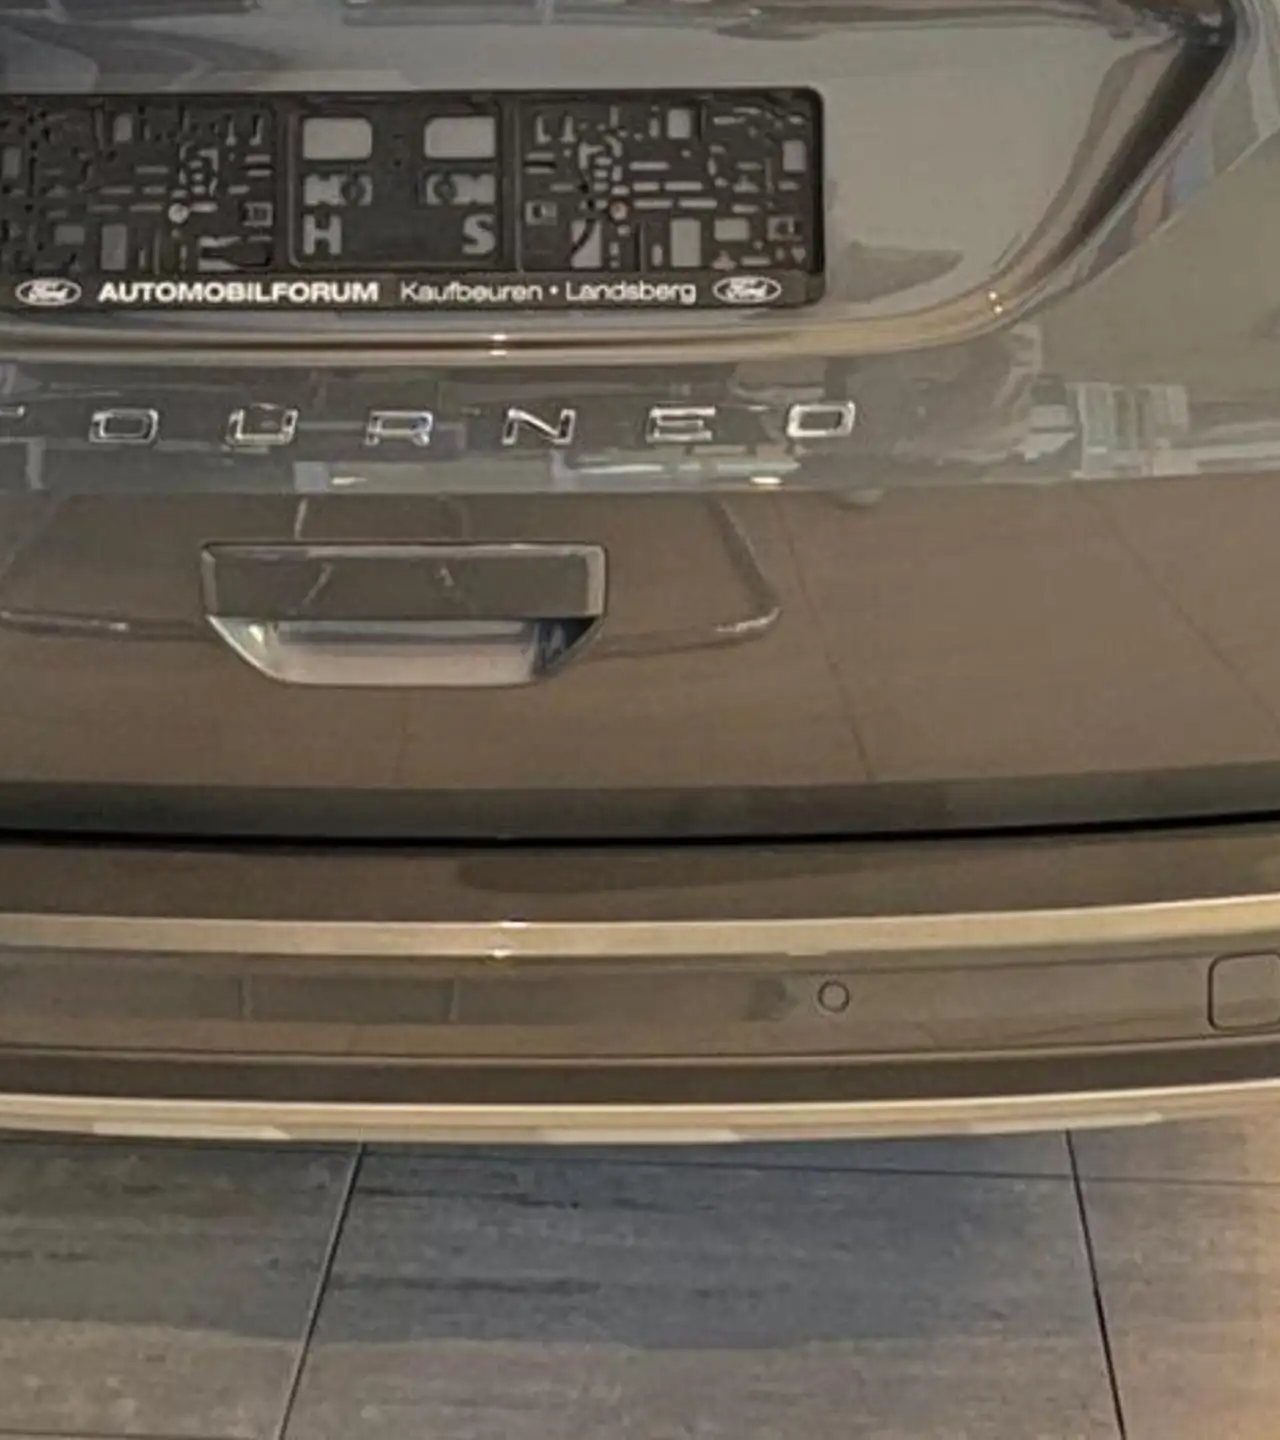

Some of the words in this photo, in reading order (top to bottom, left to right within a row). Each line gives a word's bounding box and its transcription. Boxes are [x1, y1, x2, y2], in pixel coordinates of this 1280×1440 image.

[97, 281, 380, 303] AUTOMOBILFORUM
[400, 281, 543, 302] Kaufbeuren
[565, 281, 697, 305] Landsberg
